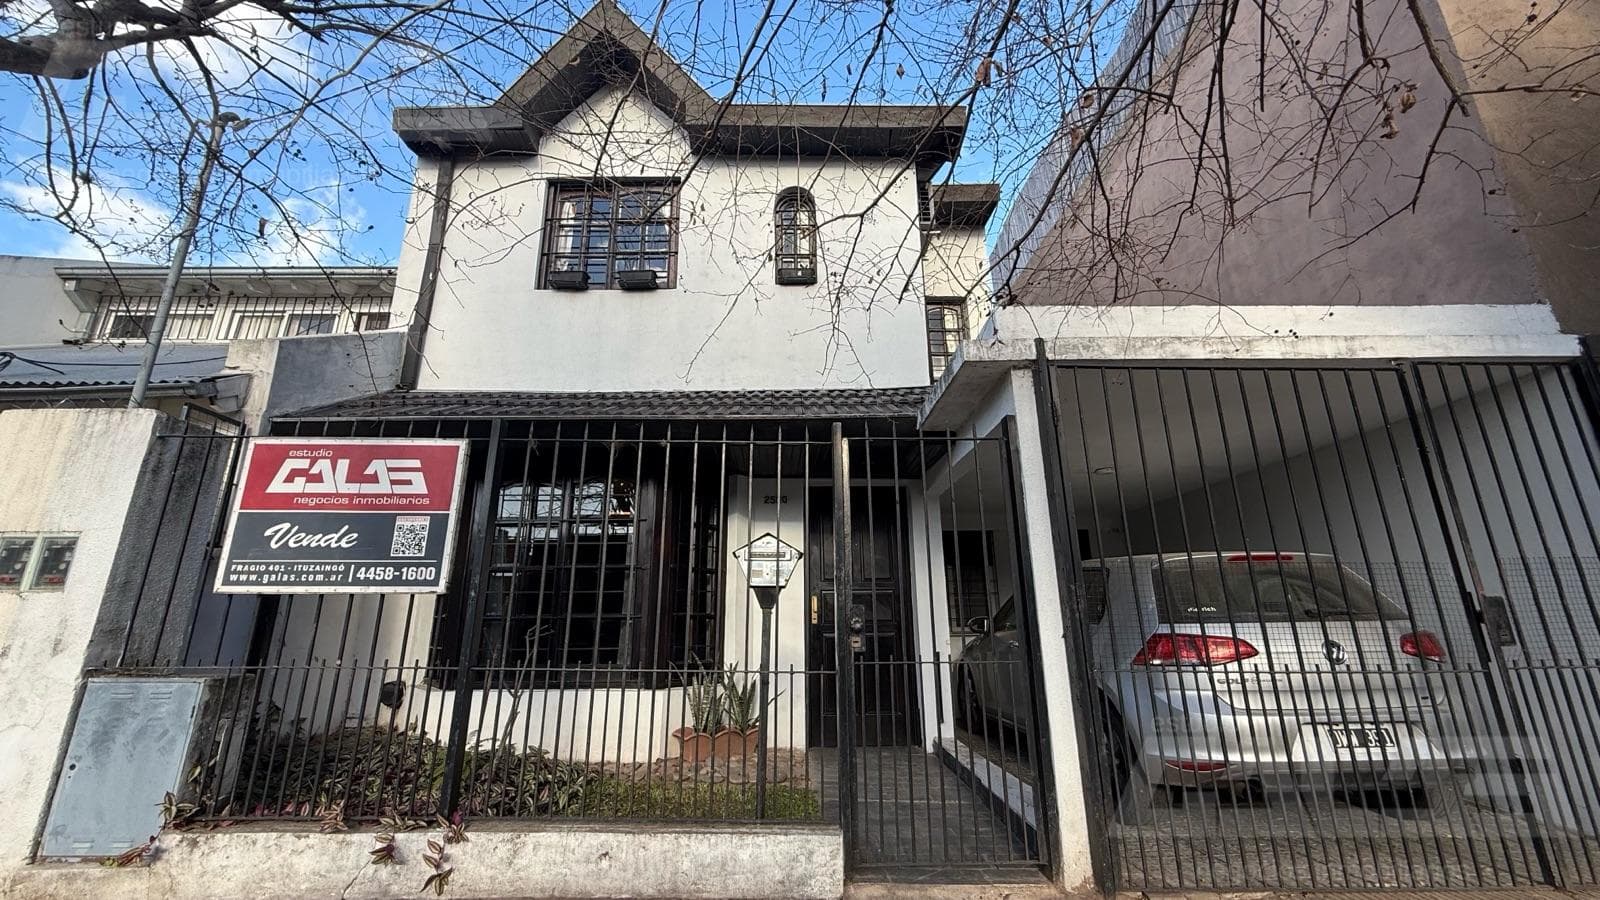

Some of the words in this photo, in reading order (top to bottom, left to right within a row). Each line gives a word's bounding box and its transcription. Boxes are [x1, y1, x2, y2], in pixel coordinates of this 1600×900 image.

[289, 449, 333, 457] estudio
[264, 459, 429, 494] GALAS
[293, 496, 349, 506] negocios
[353, 495, 430, 505] inmobiliarios
[263, 522, 358, 549] Vende
[294, 563, 345, 571] ITUZAINGÓ
[229, 572, 343, 584] www.galas.com.ar
[356, 566, 436, 581] 4458-1600
